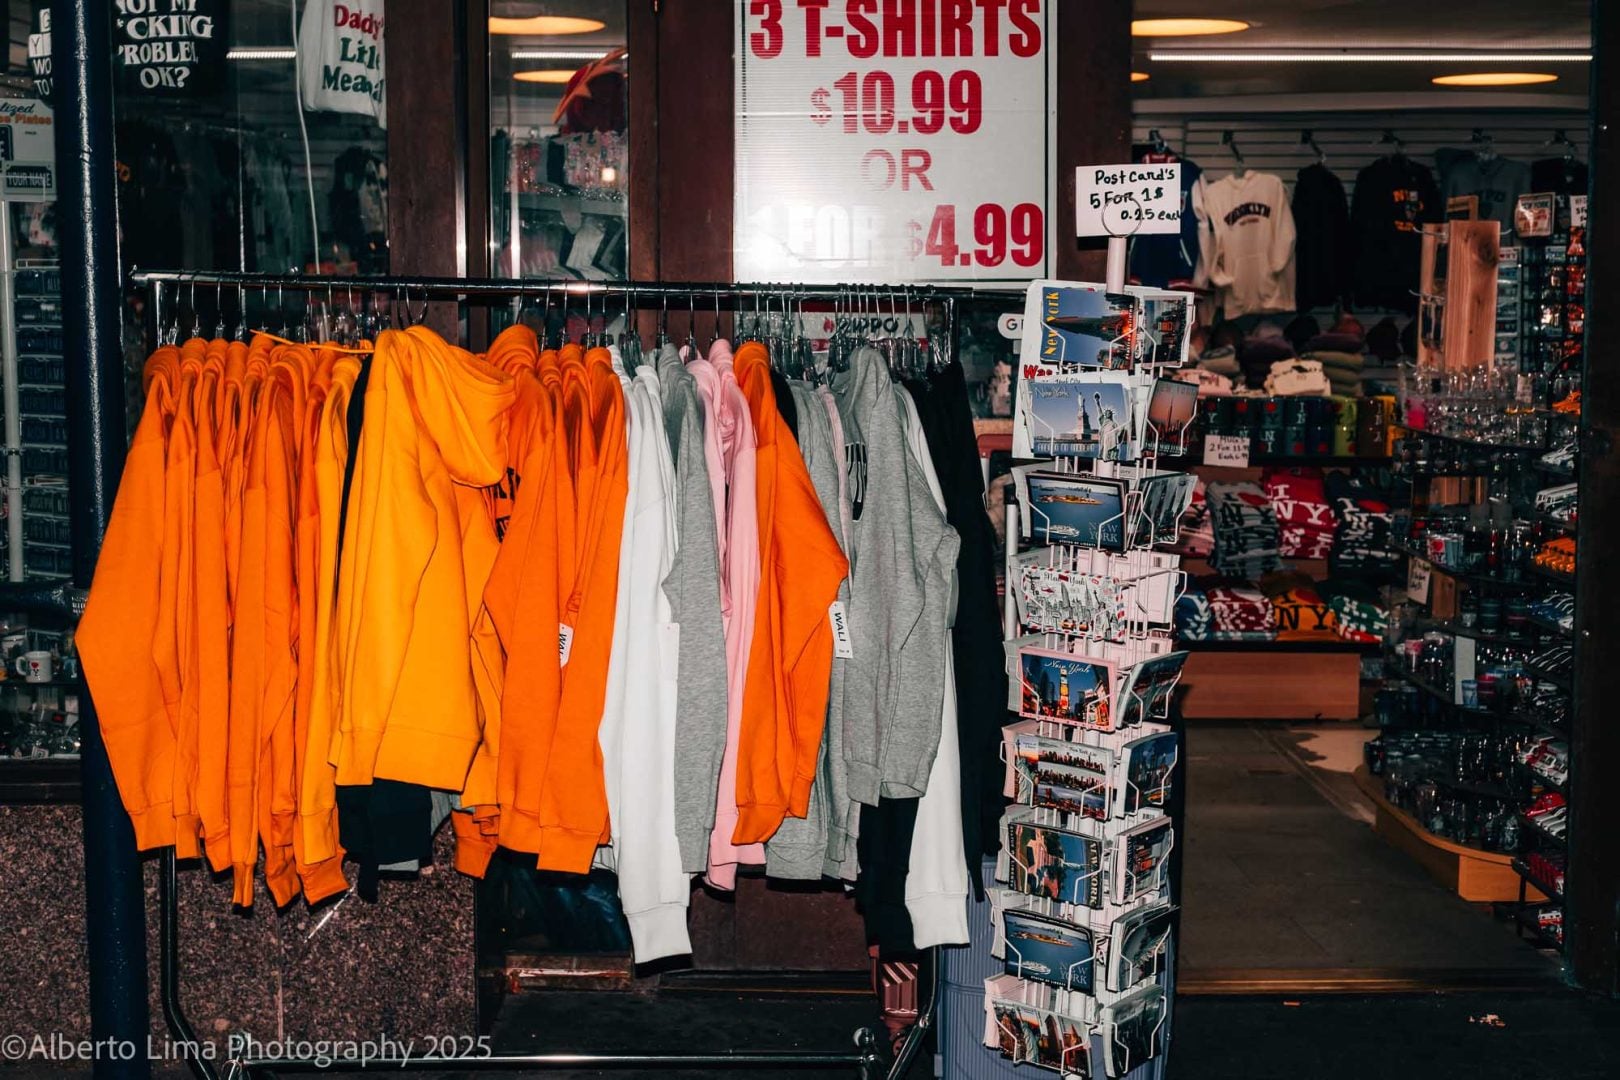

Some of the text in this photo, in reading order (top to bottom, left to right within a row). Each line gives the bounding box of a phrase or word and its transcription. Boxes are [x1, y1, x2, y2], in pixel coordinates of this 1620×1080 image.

[750, 0, 1042, 59] 3 T-SHIRTS
[118, 41, 199, 65] ROBLE
[140, 66, 190, 89] OK?
[810, 70, 982, 135] $10.99
[861, 148, 935, 191] OR
[1090, 193, 1101, 209] 5
[904, 203, 1043, 267] $4.99
